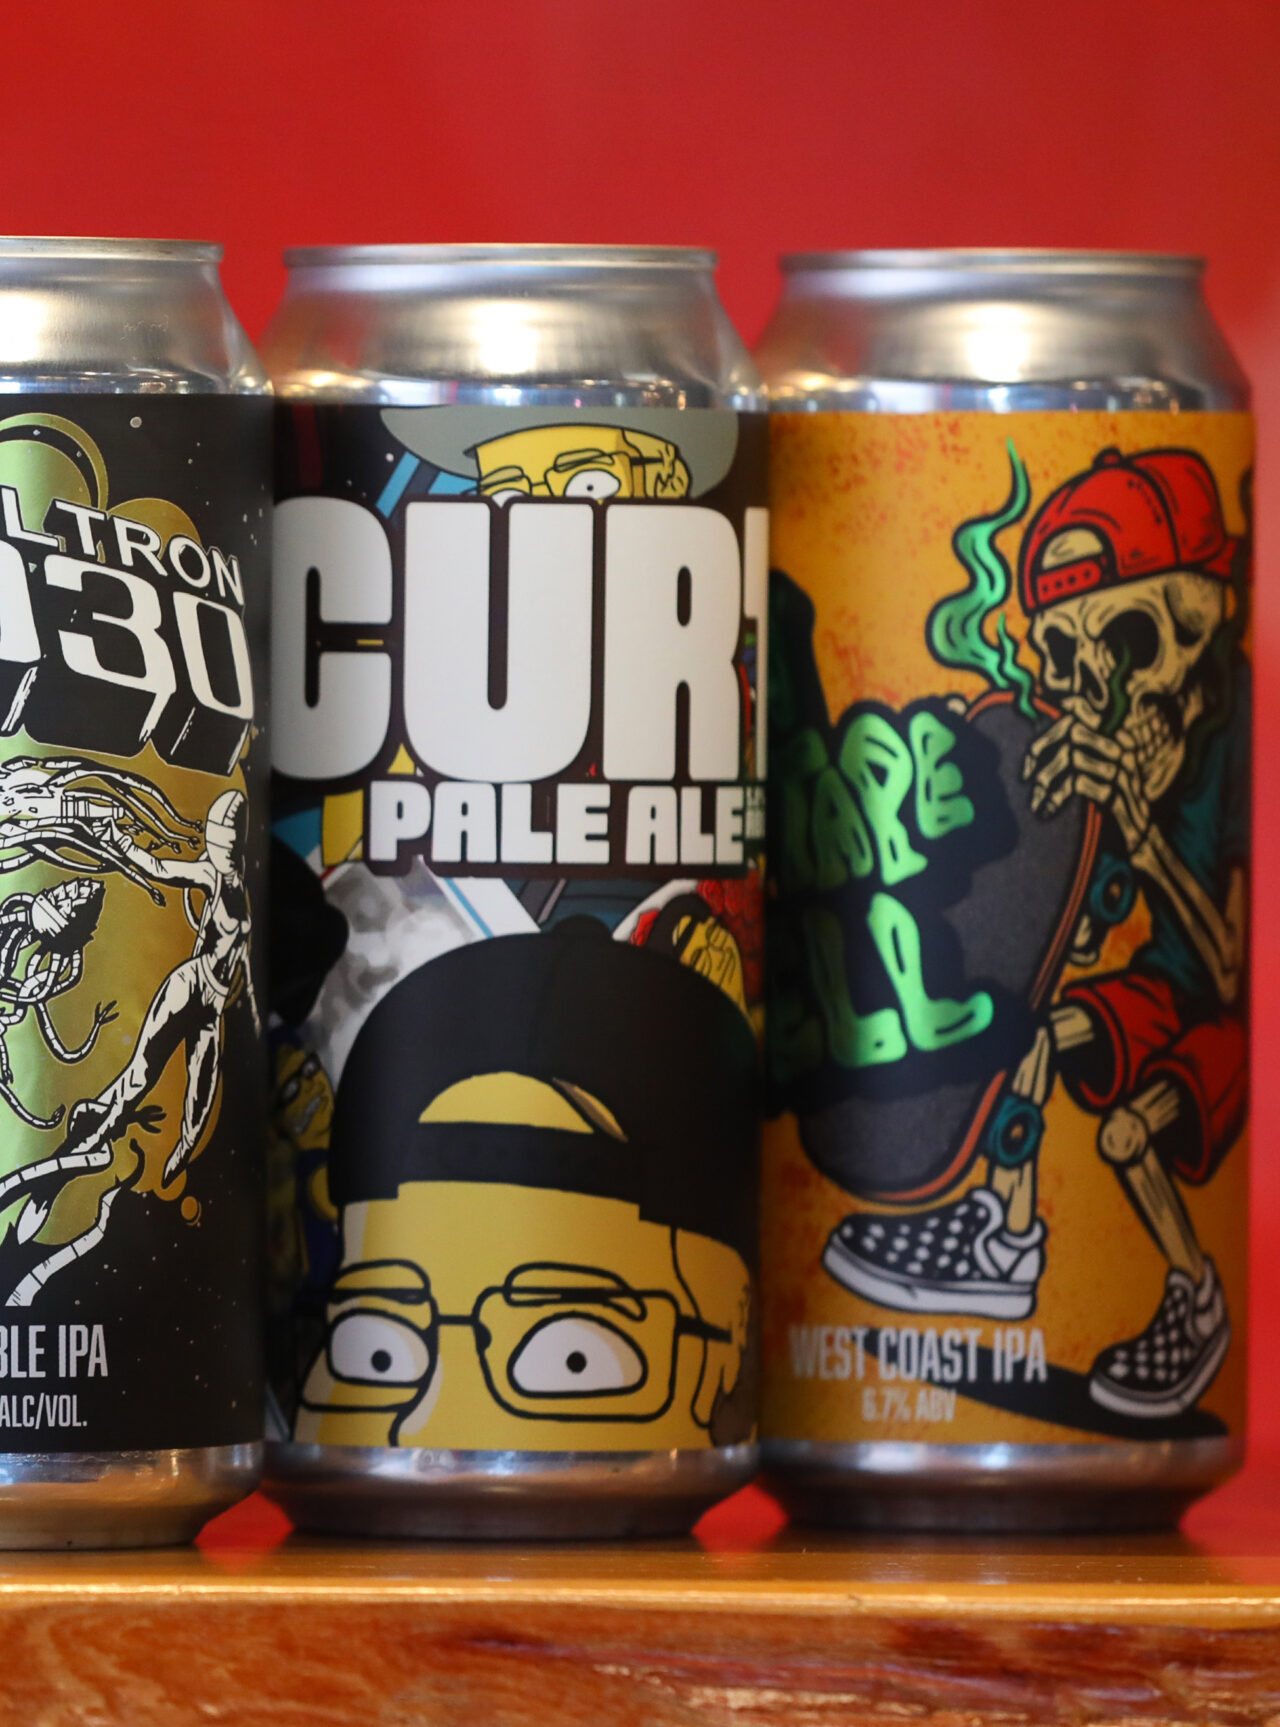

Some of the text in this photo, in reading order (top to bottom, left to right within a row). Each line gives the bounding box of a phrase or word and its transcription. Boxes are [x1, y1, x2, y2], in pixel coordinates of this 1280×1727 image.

[368, 780, 611, 864] PALE
[625, 785, 744, 865] ALE
[58, 1324, 109, 1378] IPA
[788, 1325, 1048, 1383] WEST COAST IPA
[861, 1387, 957, 1423] 6.7% ABV
